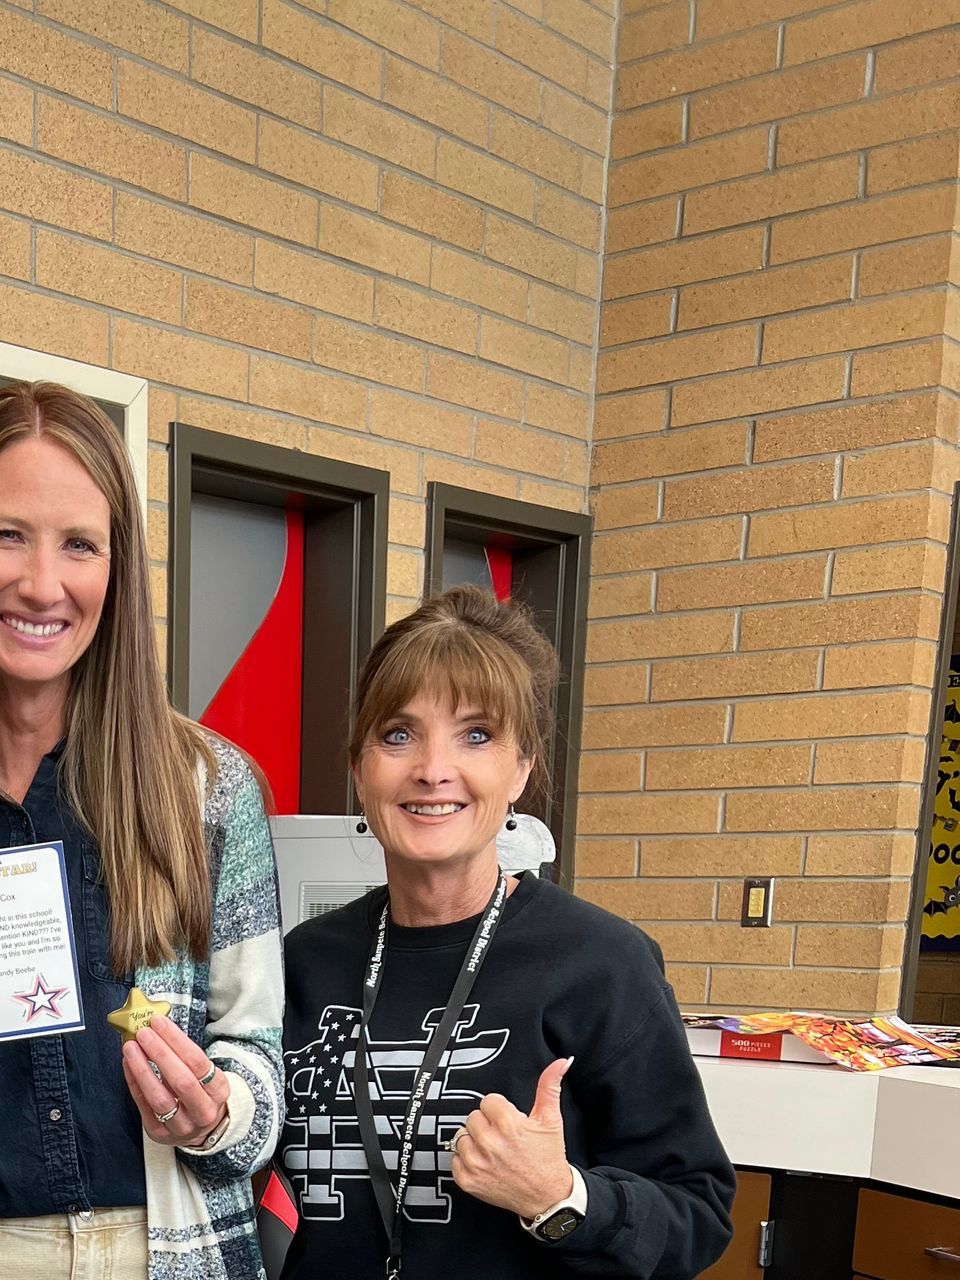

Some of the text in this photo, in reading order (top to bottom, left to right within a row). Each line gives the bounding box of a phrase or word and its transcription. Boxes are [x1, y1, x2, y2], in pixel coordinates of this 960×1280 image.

[0, 892, 15, 902] Cox
[14, 912, 27, 920] this
[481, 908, 499, 938] School
[8, 949, 20, 957] this
[21, 947, 36, 955] train
[37, 944, 51, 953] with
[14, 941, 26, 949] you
[372, 930, 386, 963] Sanpete
[467, 938, 488, 972] District
[14, 965, 35, 974] Beebe
[366, 961, 381, 987] North
[731, 1039, 750, 1047] 500
[414, 1071, 432, 1101] North
[405, 1100, 422, 1141] Sanpete
[400, 1142, 412, 1176] School
